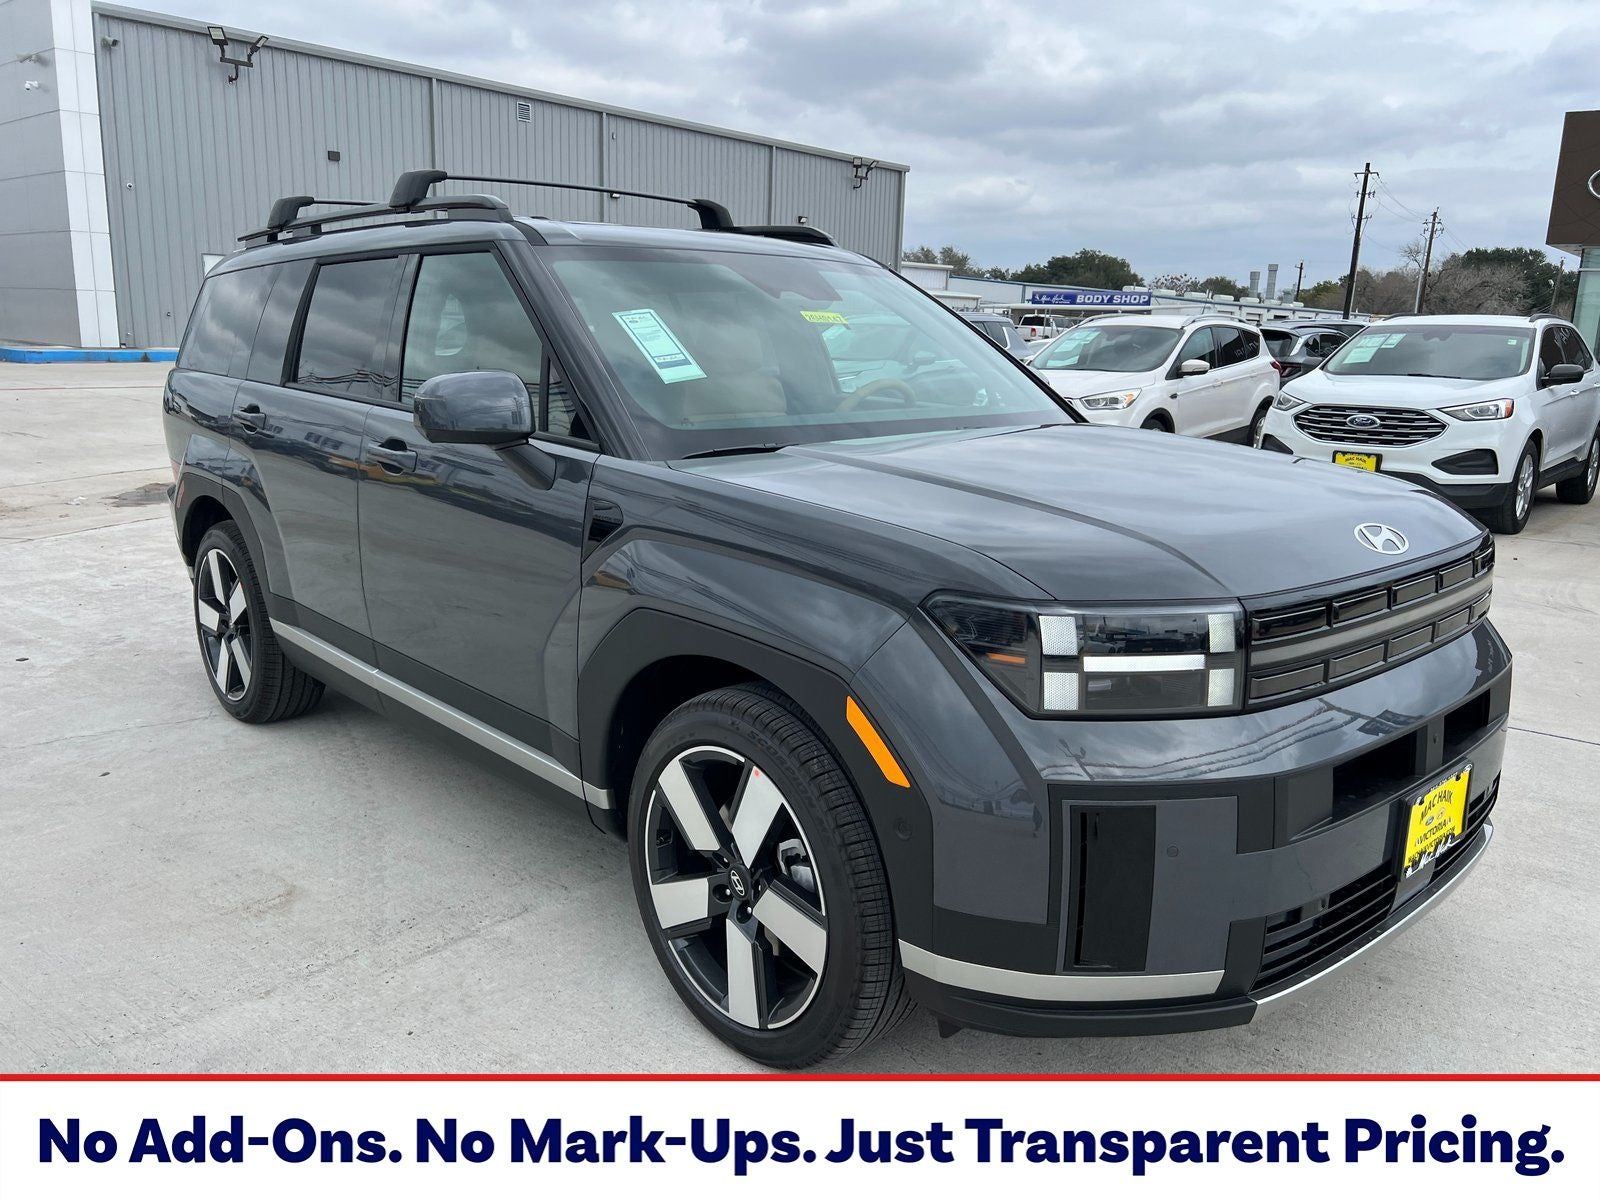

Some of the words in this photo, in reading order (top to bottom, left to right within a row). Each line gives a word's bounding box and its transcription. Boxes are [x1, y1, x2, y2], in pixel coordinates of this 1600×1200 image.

[1076, 294, 1110, 303] BODY
[1113, 294, 1148, 304] SHOP
[1420, 794, 1436, 822] MAC
[1437, 790, 1453, 804] HAIK
